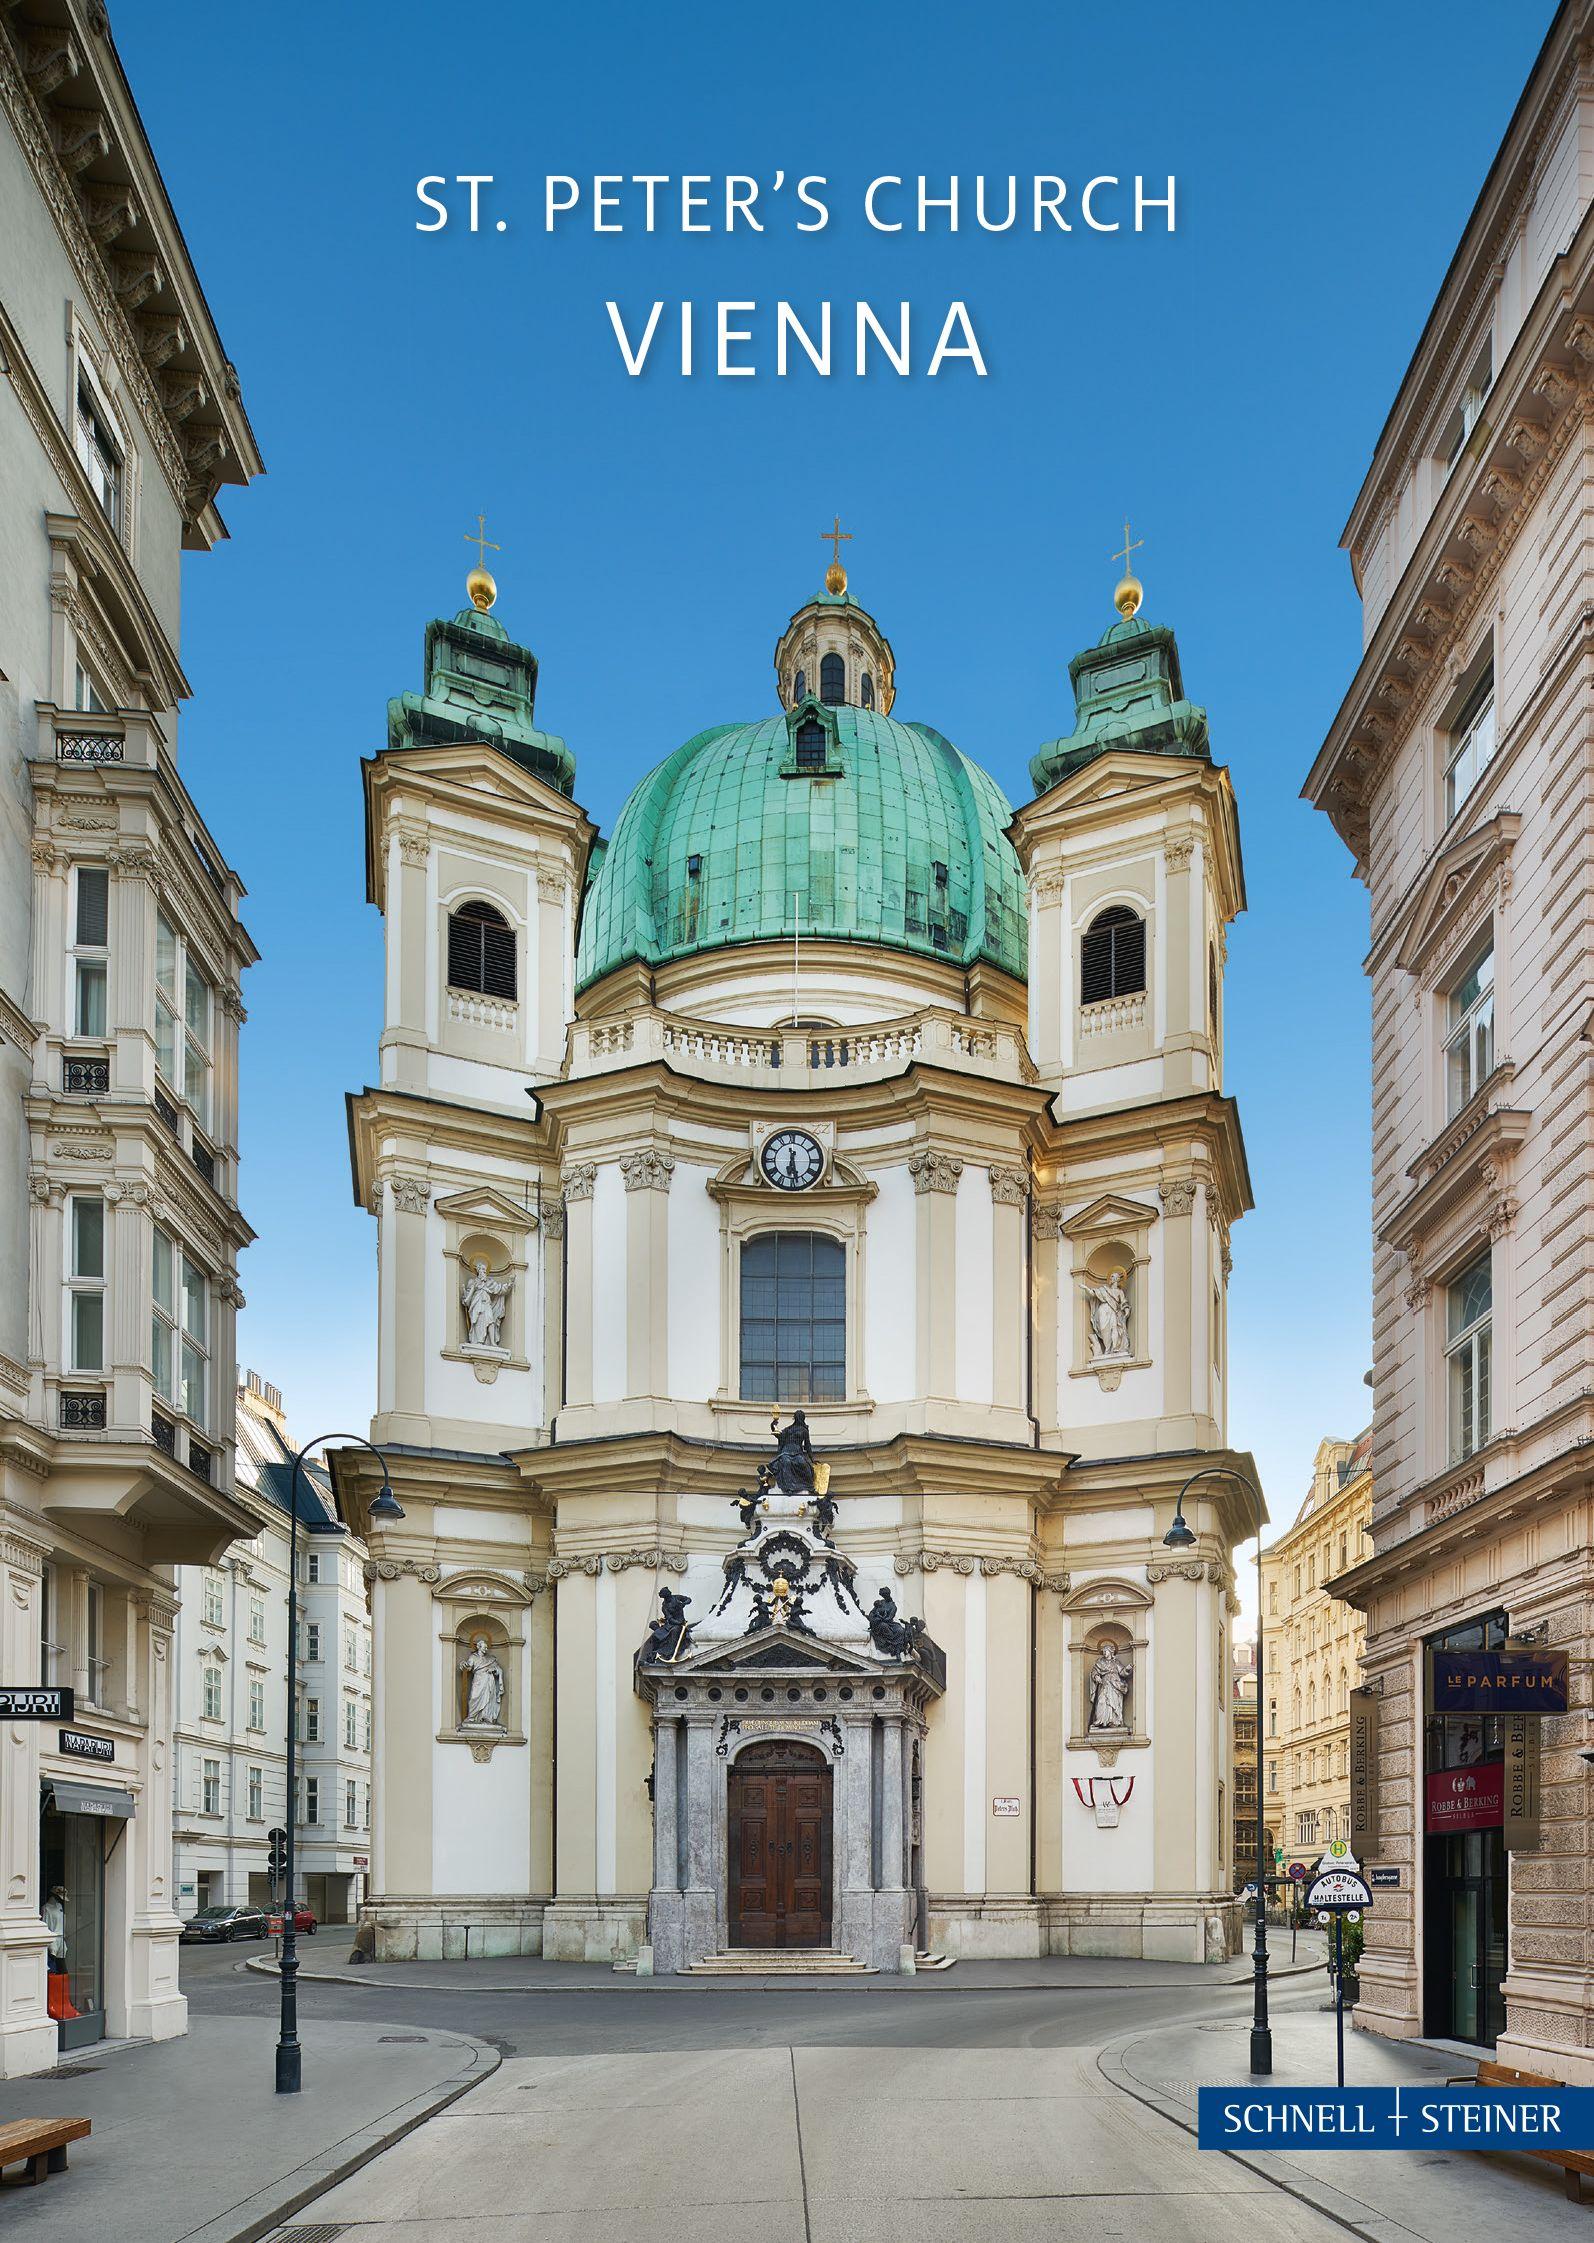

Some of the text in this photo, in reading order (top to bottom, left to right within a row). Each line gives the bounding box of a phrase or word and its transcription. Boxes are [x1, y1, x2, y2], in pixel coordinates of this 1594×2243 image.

[1448, 1675, 1553, 1688] LE PARFUM
[1512, 1748, 1523, 1758] &
[1355, 1716, 1366, 1832] ROBBE & BERKING
[1511, 1764, 1523, 1818] ROBBE
[1431, 1794, 1499, 1812] ROBBE & BERKING
[1321, 1875, 1357, 1887] AUTOBUS
[1314, 1894, 1364, 1902] HALTESTELLE
